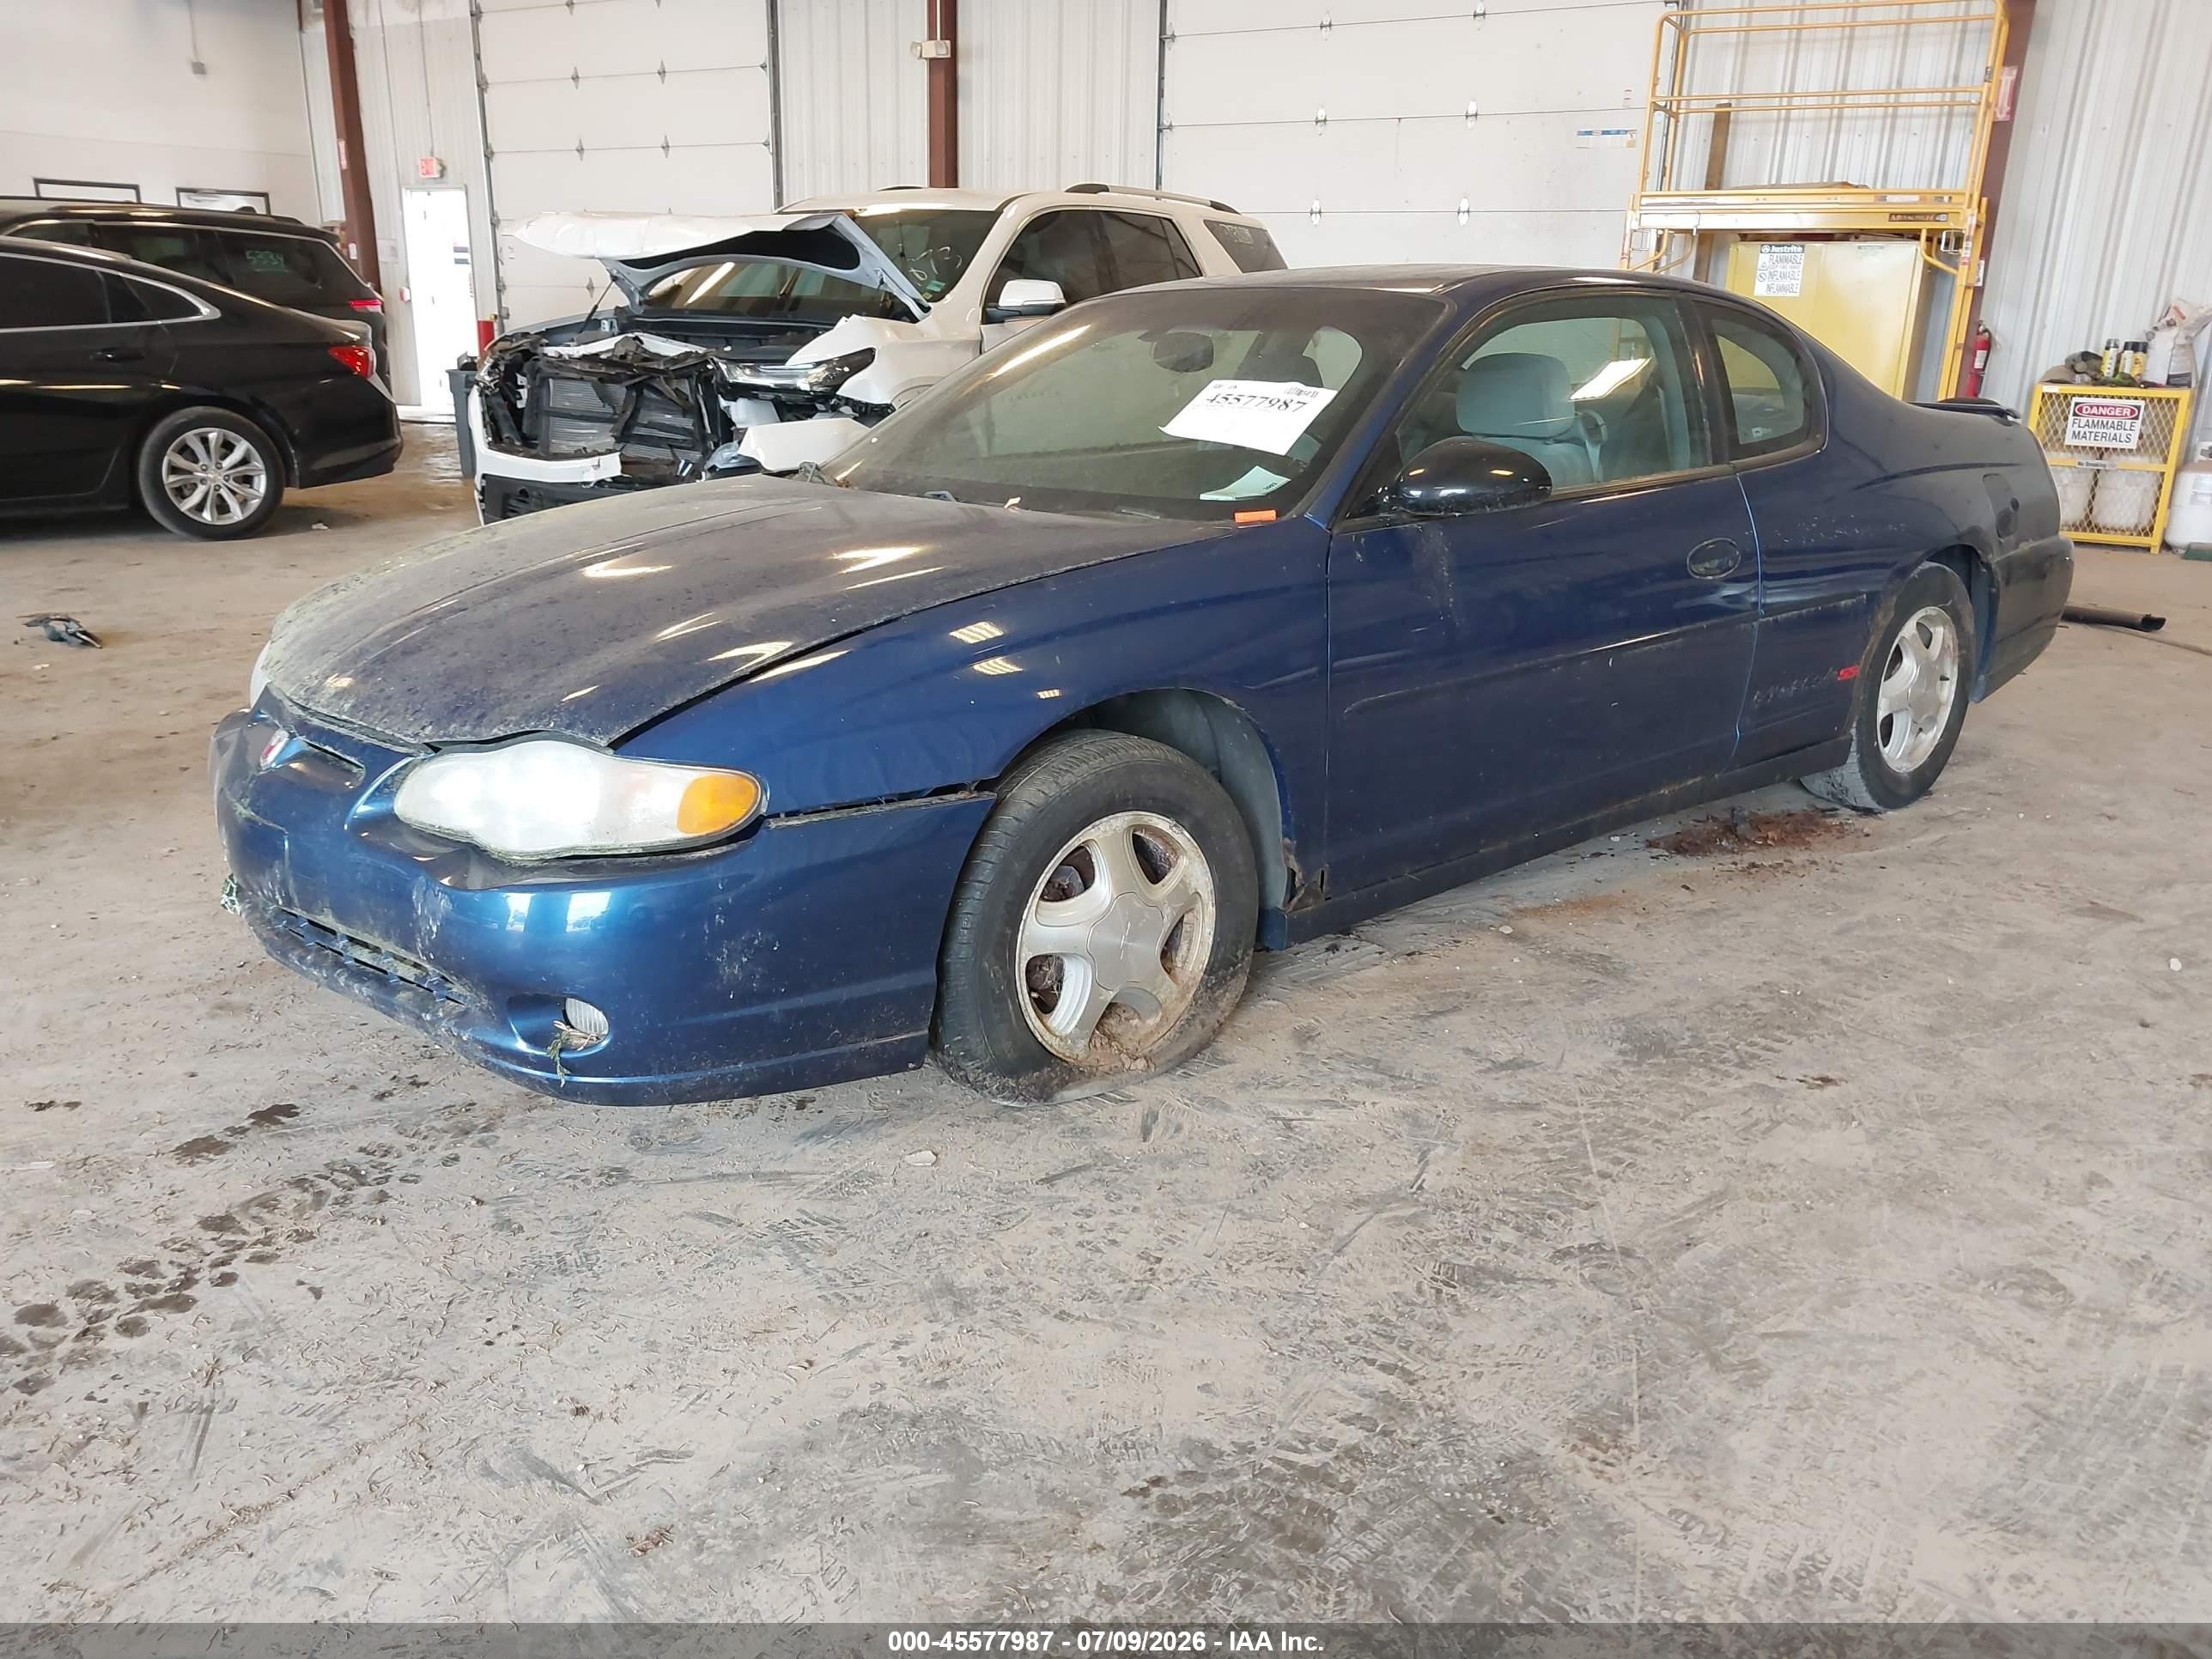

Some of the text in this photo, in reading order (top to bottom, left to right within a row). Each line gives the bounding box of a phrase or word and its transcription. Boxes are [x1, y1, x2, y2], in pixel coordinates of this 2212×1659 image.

[1769, 254, 1803, 264] FLAMMABLE
[1206, 393, 1308, 412] 45577987
[2081, 405, 2131, 416] DANGER
[2071, 417, 2137, 431] FLAMMABLE
[2071, 430, 2132, 443] MATERIALS
